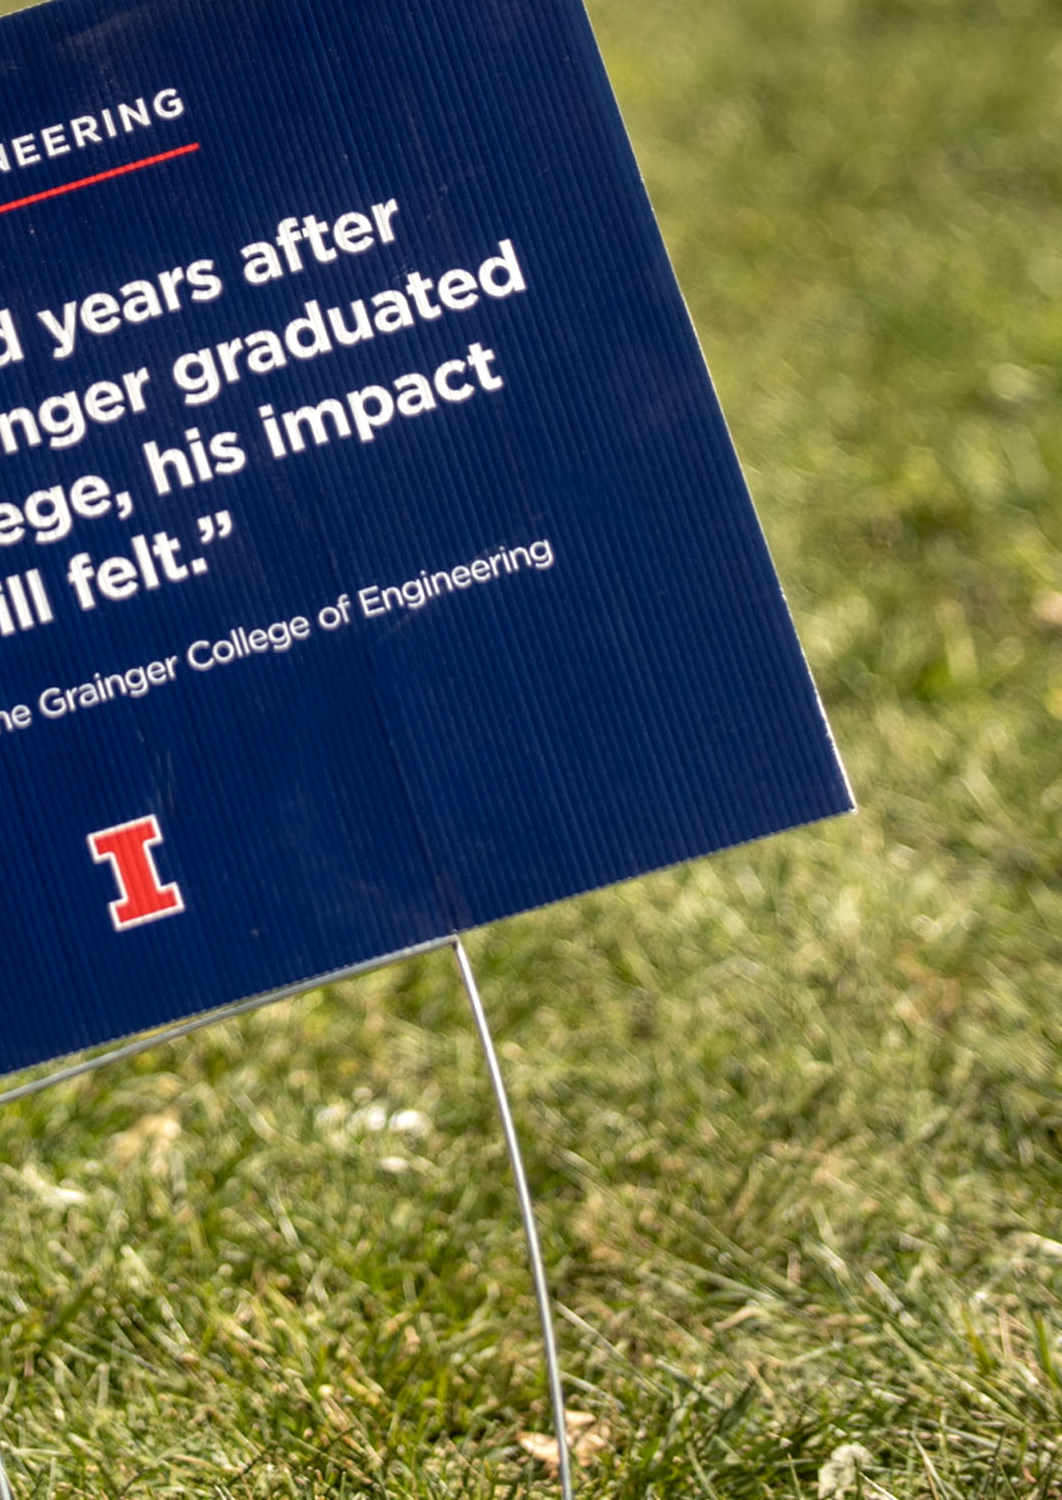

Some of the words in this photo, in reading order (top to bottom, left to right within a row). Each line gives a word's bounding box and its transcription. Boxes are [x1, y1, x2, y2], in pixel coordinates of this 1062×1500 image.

[36, 258, 223, 360] years
[240, 197, 399, 286] after
[172, 238, 527, 407] graduated
[142, 426, 247, 496] his
[257, 341, 504, 459] impact
[38, 655, 178, 719] Grainger
[186, 615, 311, 671] College
[317, 593, 351, 630] of
[357, 539, 555, 618] Engineering
[66, 509, 233, 611] felt.”
[86, 813, 186, 933] I
